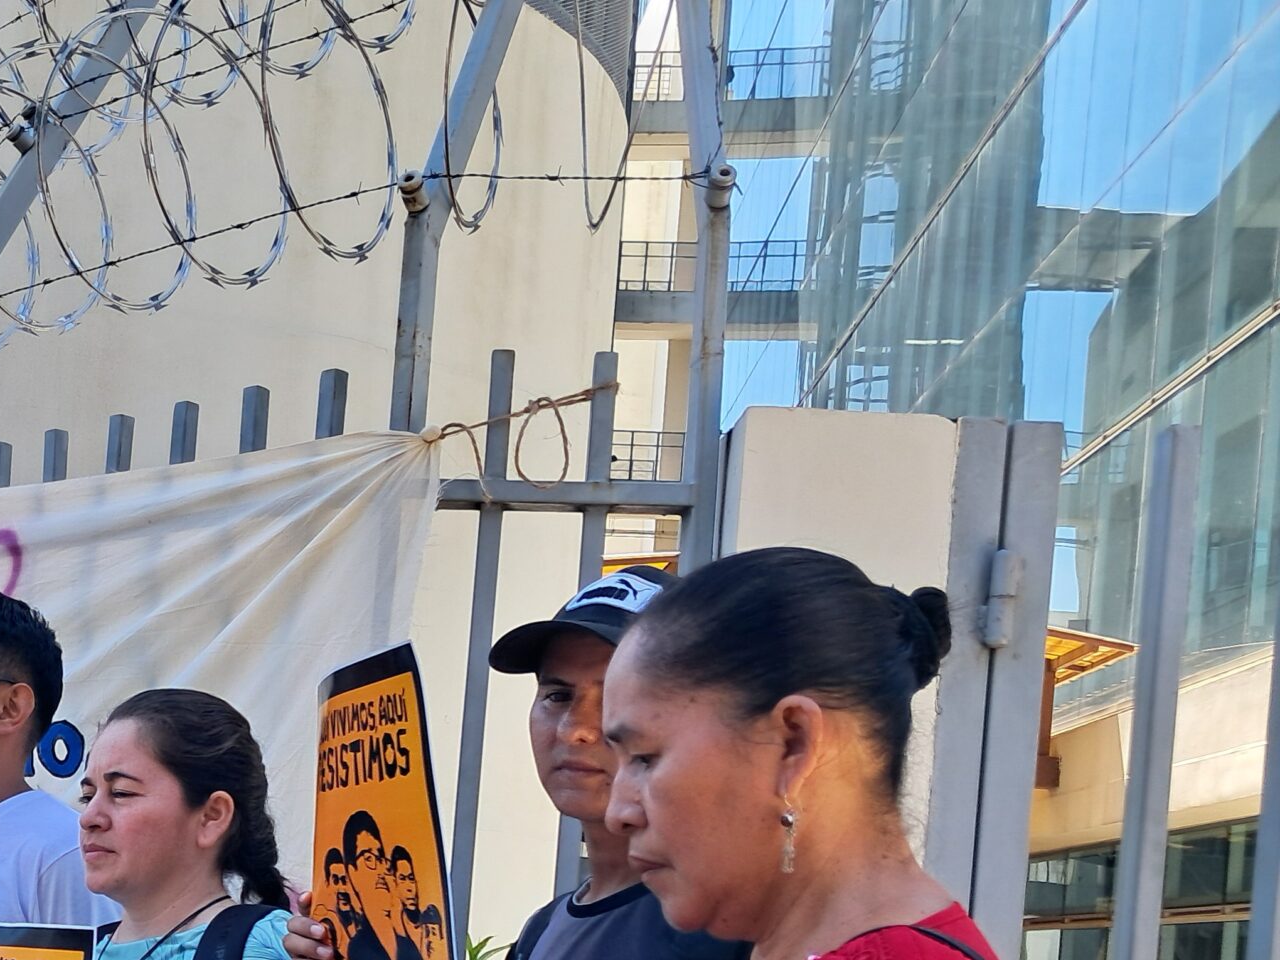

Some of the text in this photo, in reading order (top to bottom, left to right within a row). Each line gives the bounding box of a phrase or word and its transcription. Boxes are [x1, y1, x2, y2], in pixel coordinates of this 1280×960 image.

[331, 701, 378, 733] VIVIMOS,
[378, 687, 408, 726] AQUÍ
[320, 728, 410, 793] ESISTIMOS
